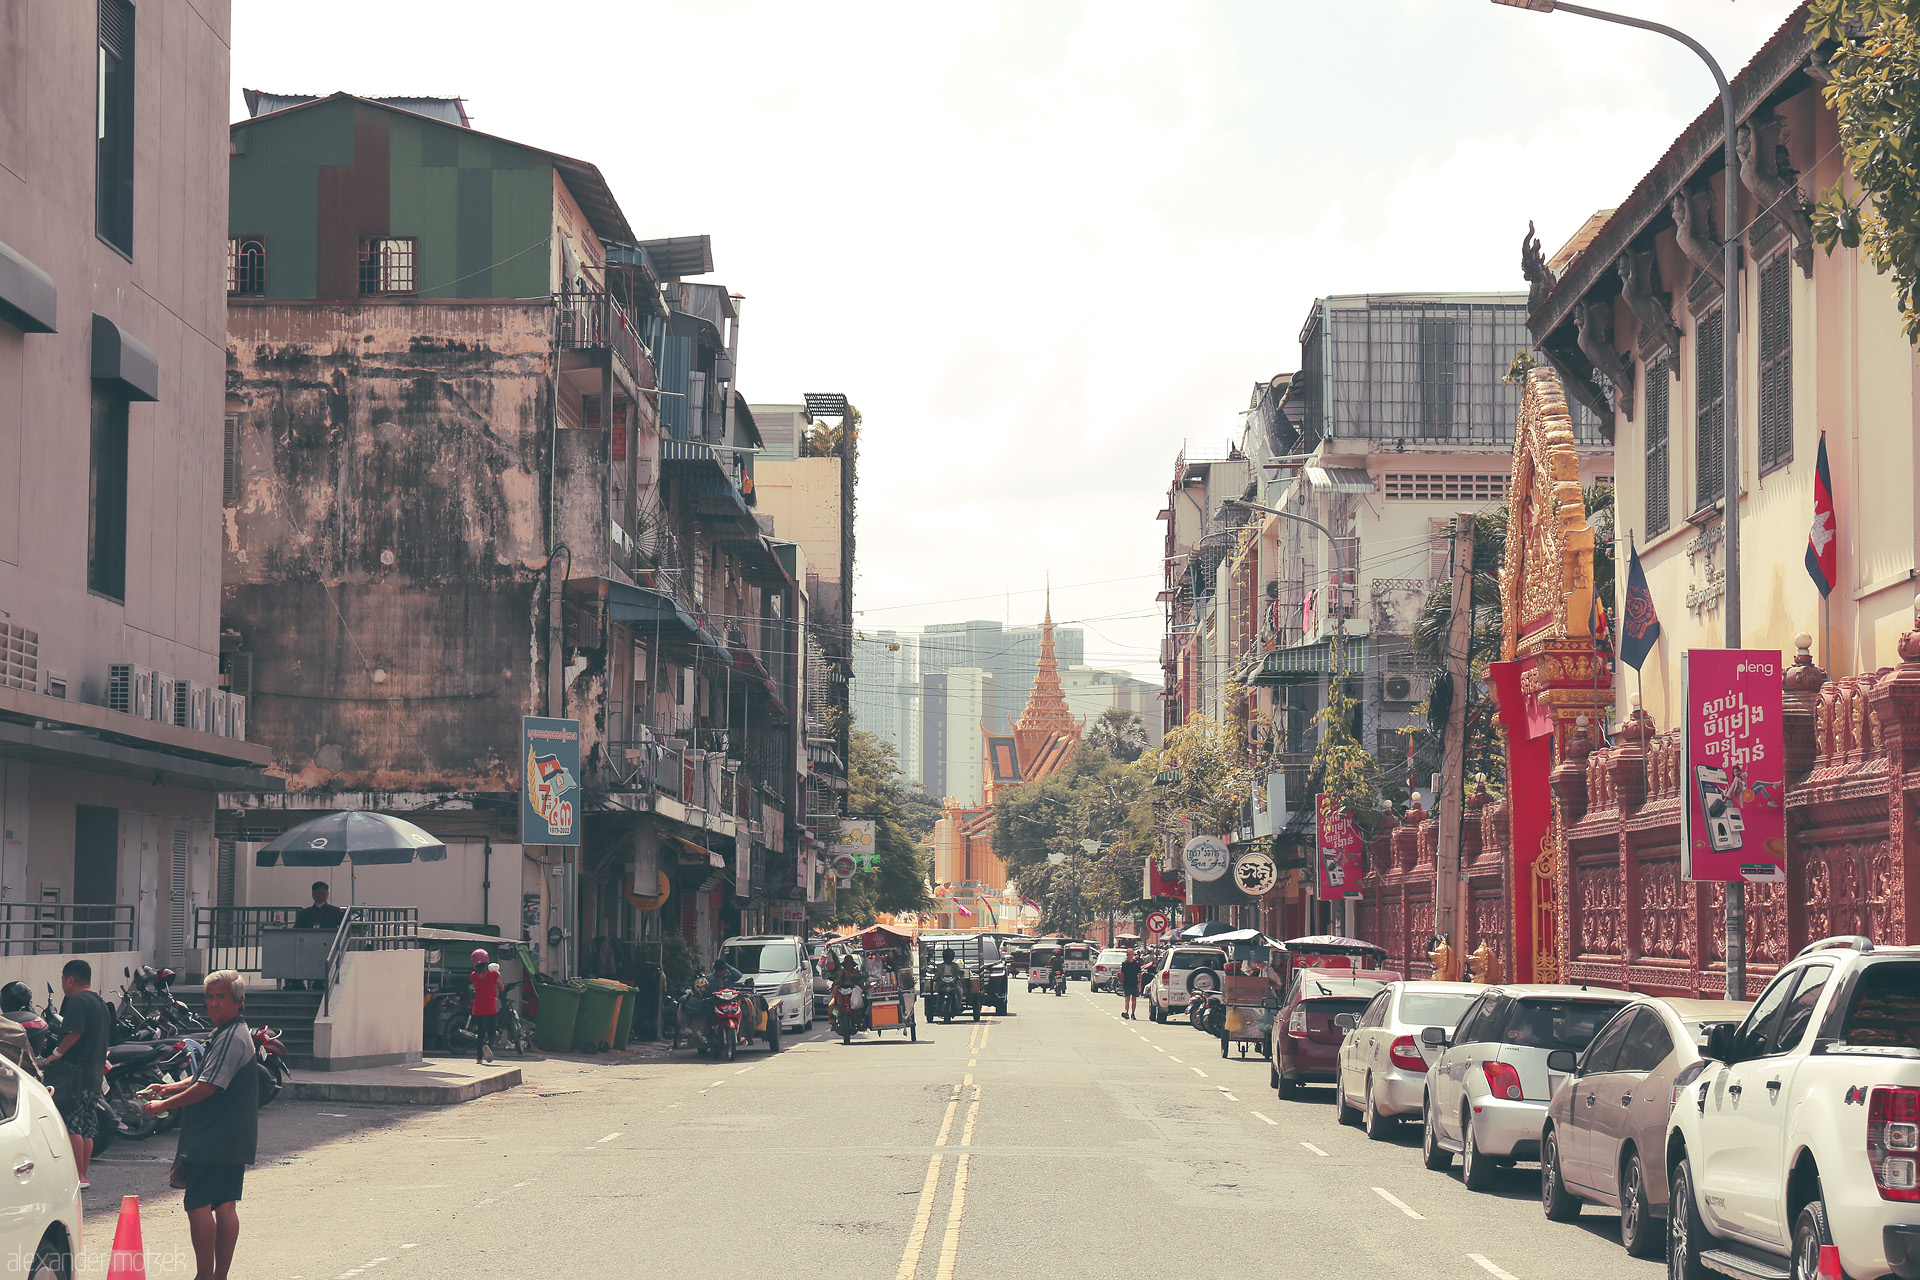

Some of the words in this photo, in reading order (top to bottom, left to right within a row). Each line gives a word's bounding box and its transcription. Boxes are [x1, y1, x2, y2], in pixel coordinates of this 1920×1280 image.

[1736, 659, 1774, 680] pleng
[1705, 738, 1731, 755] បាន
[538, 784, 551, 815] 7
